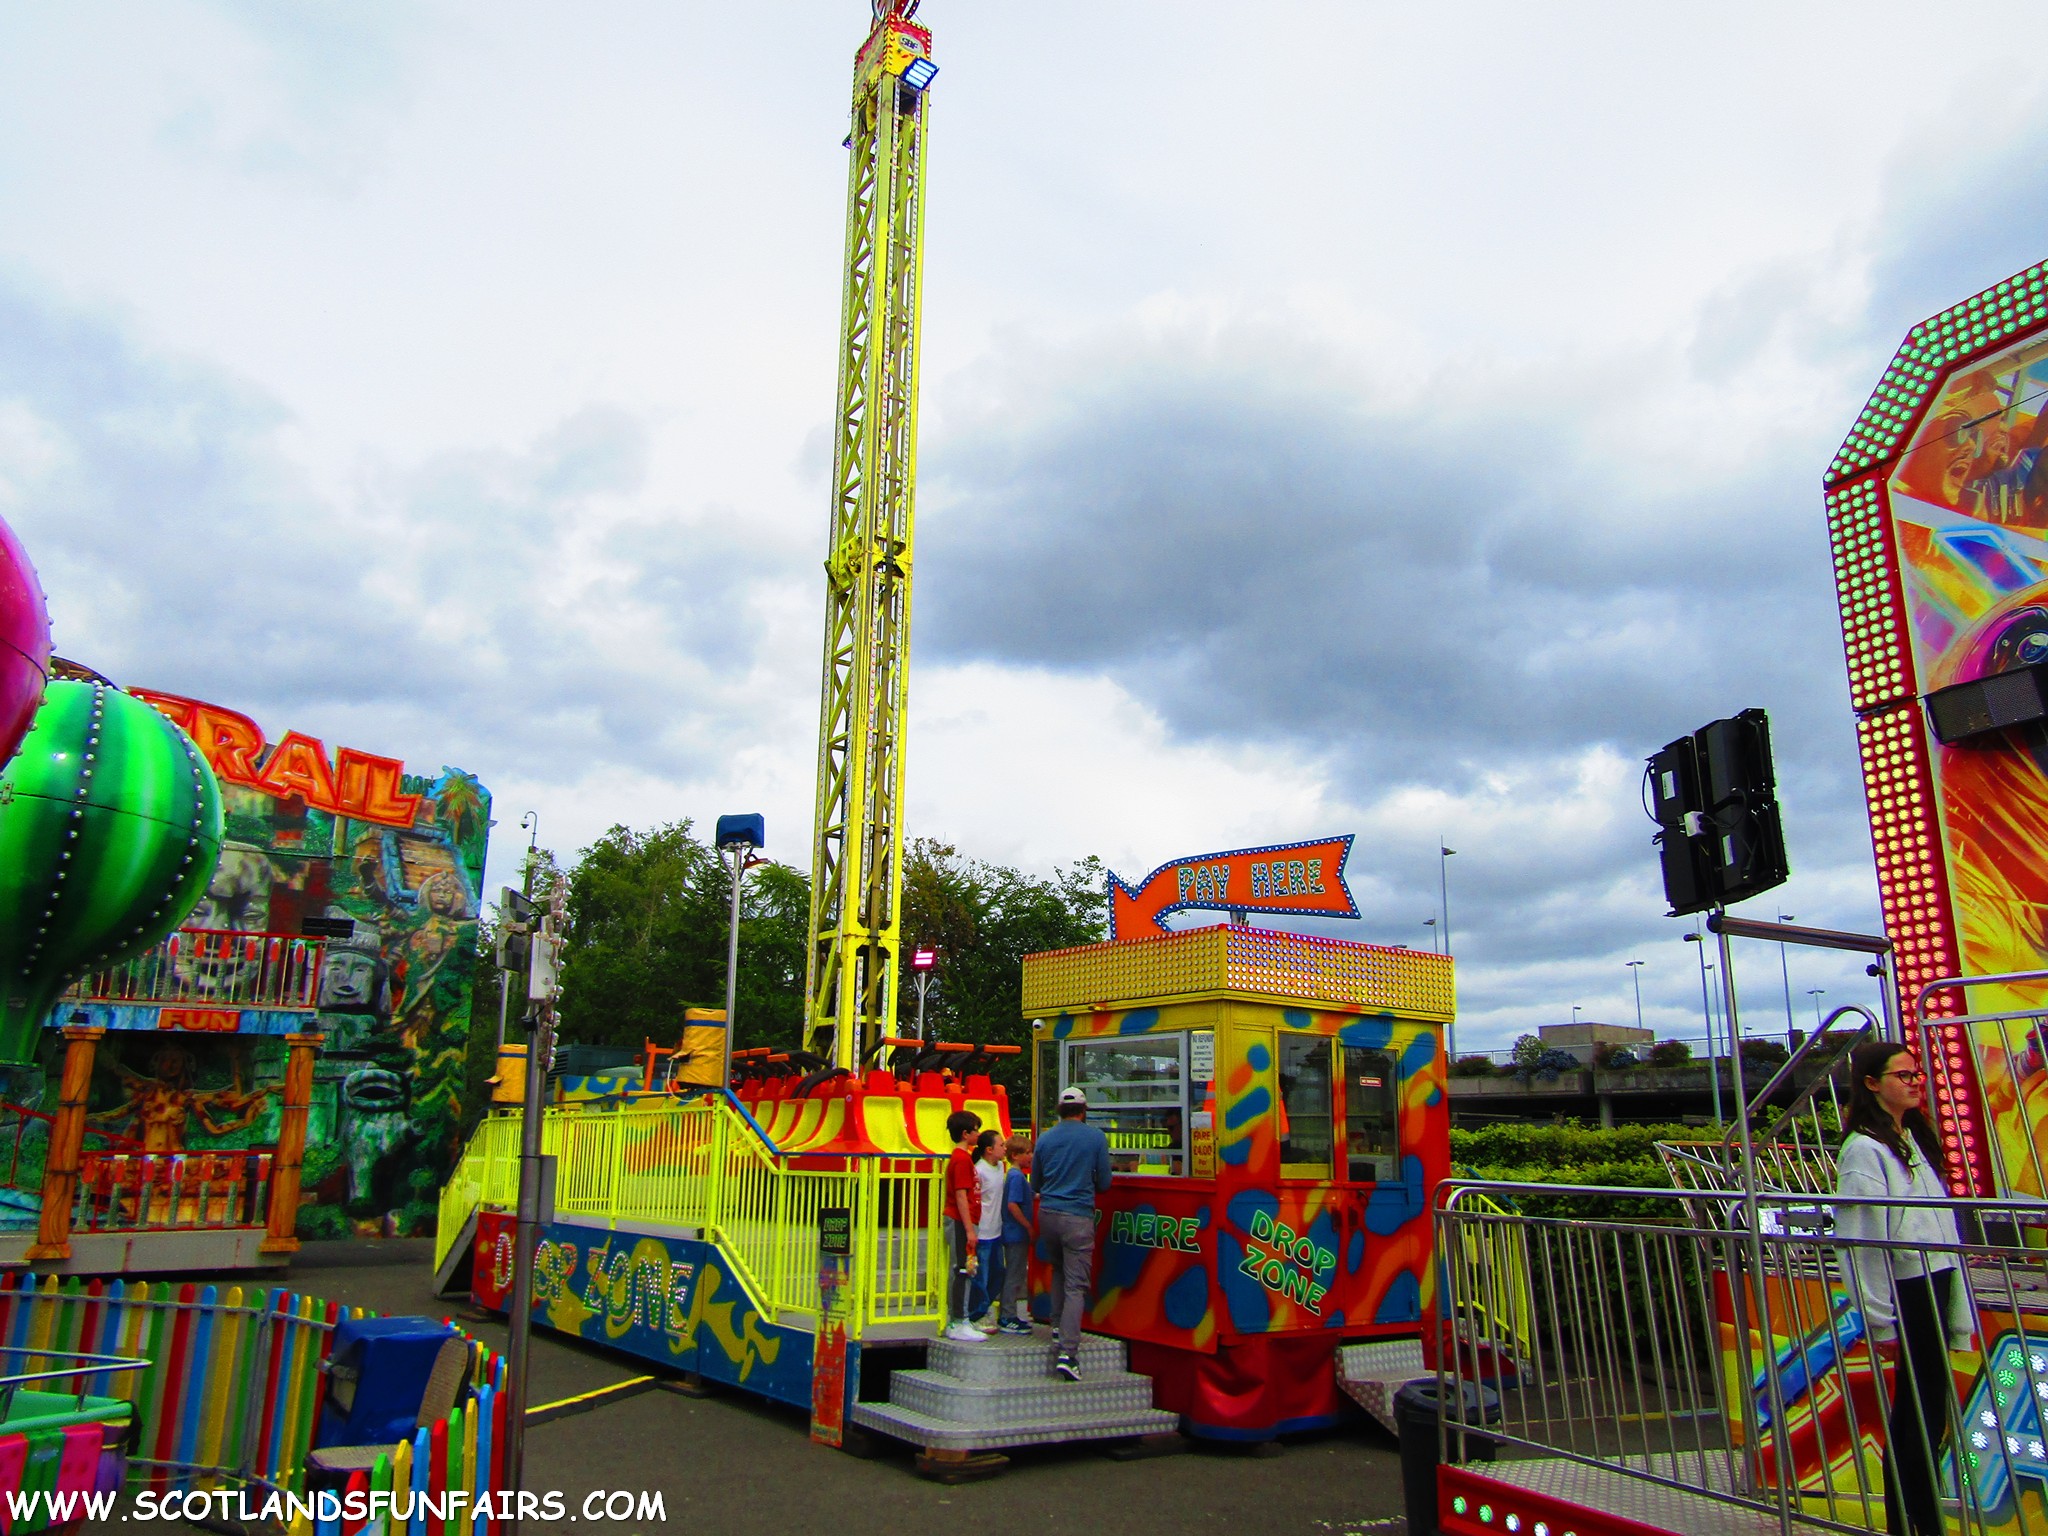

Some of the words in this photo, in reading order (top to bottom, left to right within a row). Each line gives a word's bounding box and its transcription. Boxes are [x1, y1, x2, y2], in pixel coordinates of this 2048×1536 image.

[1178, 864, 1230, 902] PAY
[1251, 859, 1326, 899] HERE
[159, 1010, 239, 1031] FUN
[1193, 1131, 1211, 1141] FARE
[822, 1234, 849, 1248] ZONE
[1111, 1211, 1201, 1253] HERE
[1250, 1209, 1336, 1277] DROP
[495, 1232, 578, 1303] DOP
[583, 1246, 695, 1337] ZONE
[1238, 1243, 1328, 1316] ZONE
